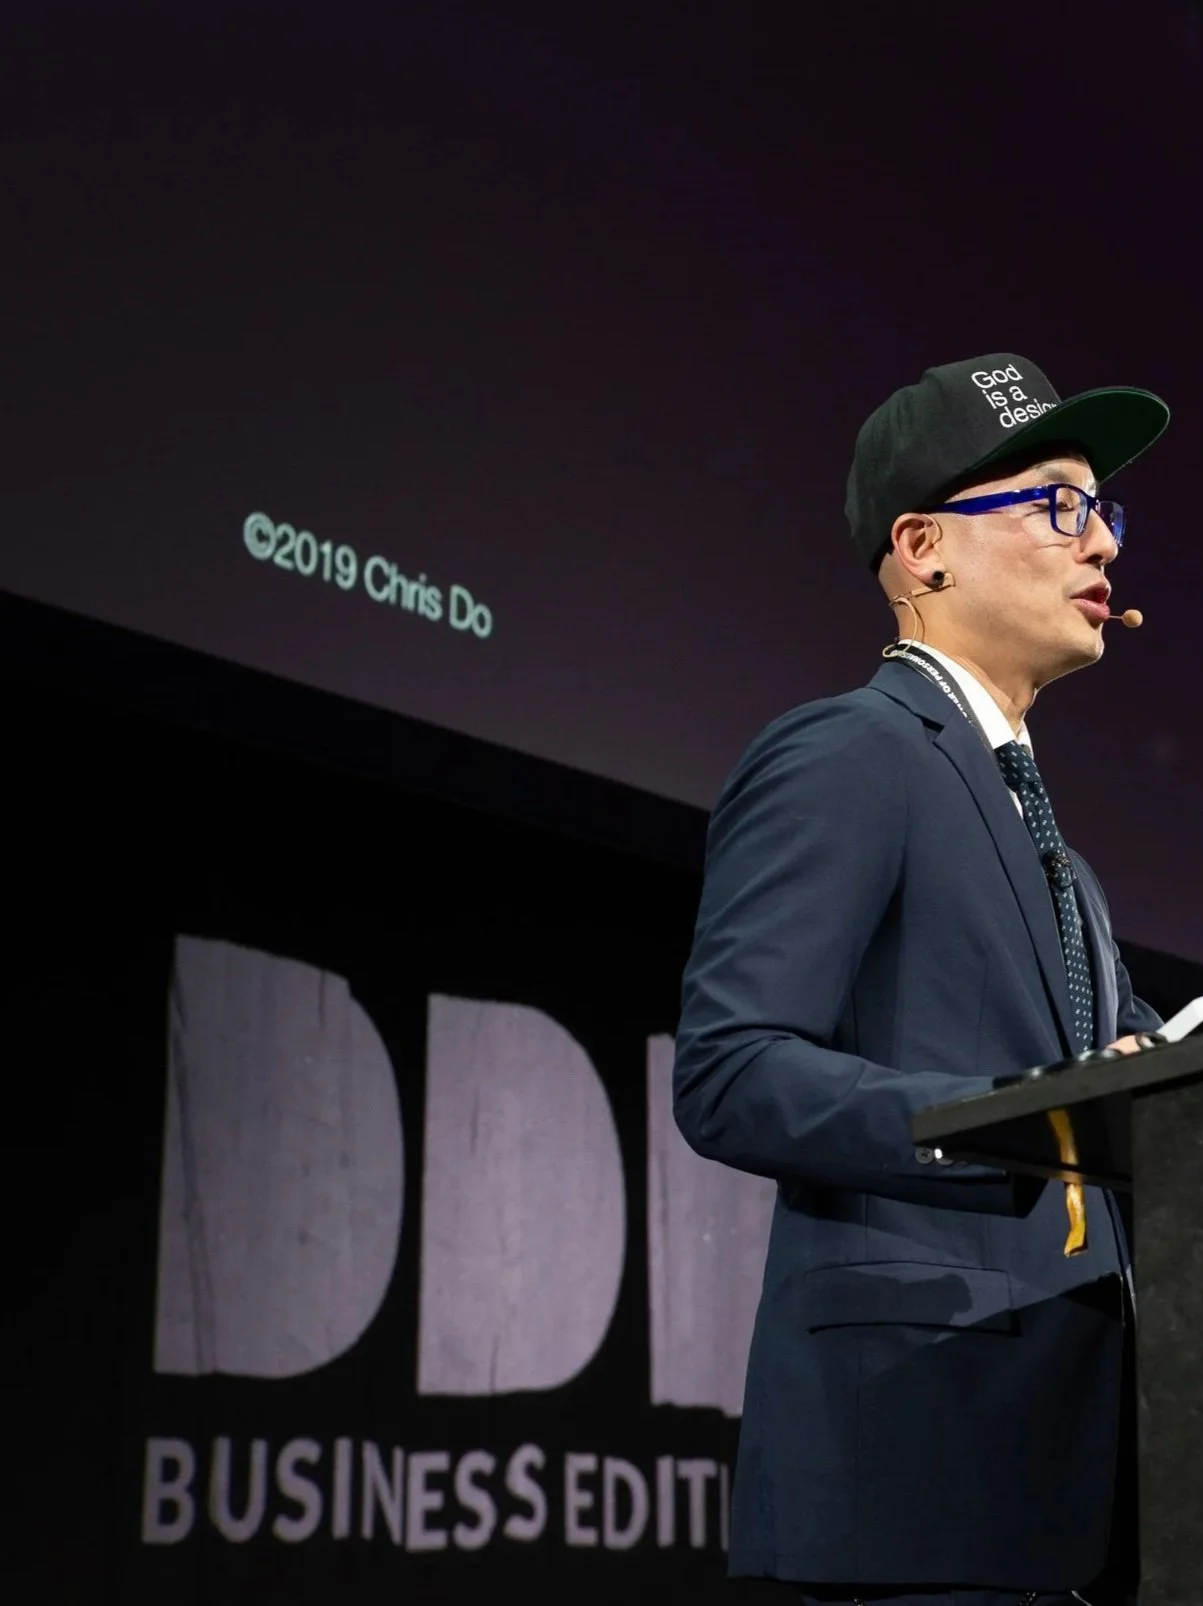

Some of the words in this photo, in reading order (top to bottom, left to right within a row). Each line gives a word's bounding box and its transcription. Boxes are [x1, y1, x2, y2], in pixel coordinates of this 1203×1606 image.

[971, 364, 1023, 388] God
[982, 389, 1008, 409] is
[1009, 386, 1028, 401] a
[243, 512, 358, 590] ©2019
[364, 556, 443, 621] Chris
[449, 584, 493, 638] Do
[142, 1437, 548, 1552] BUSINESS
